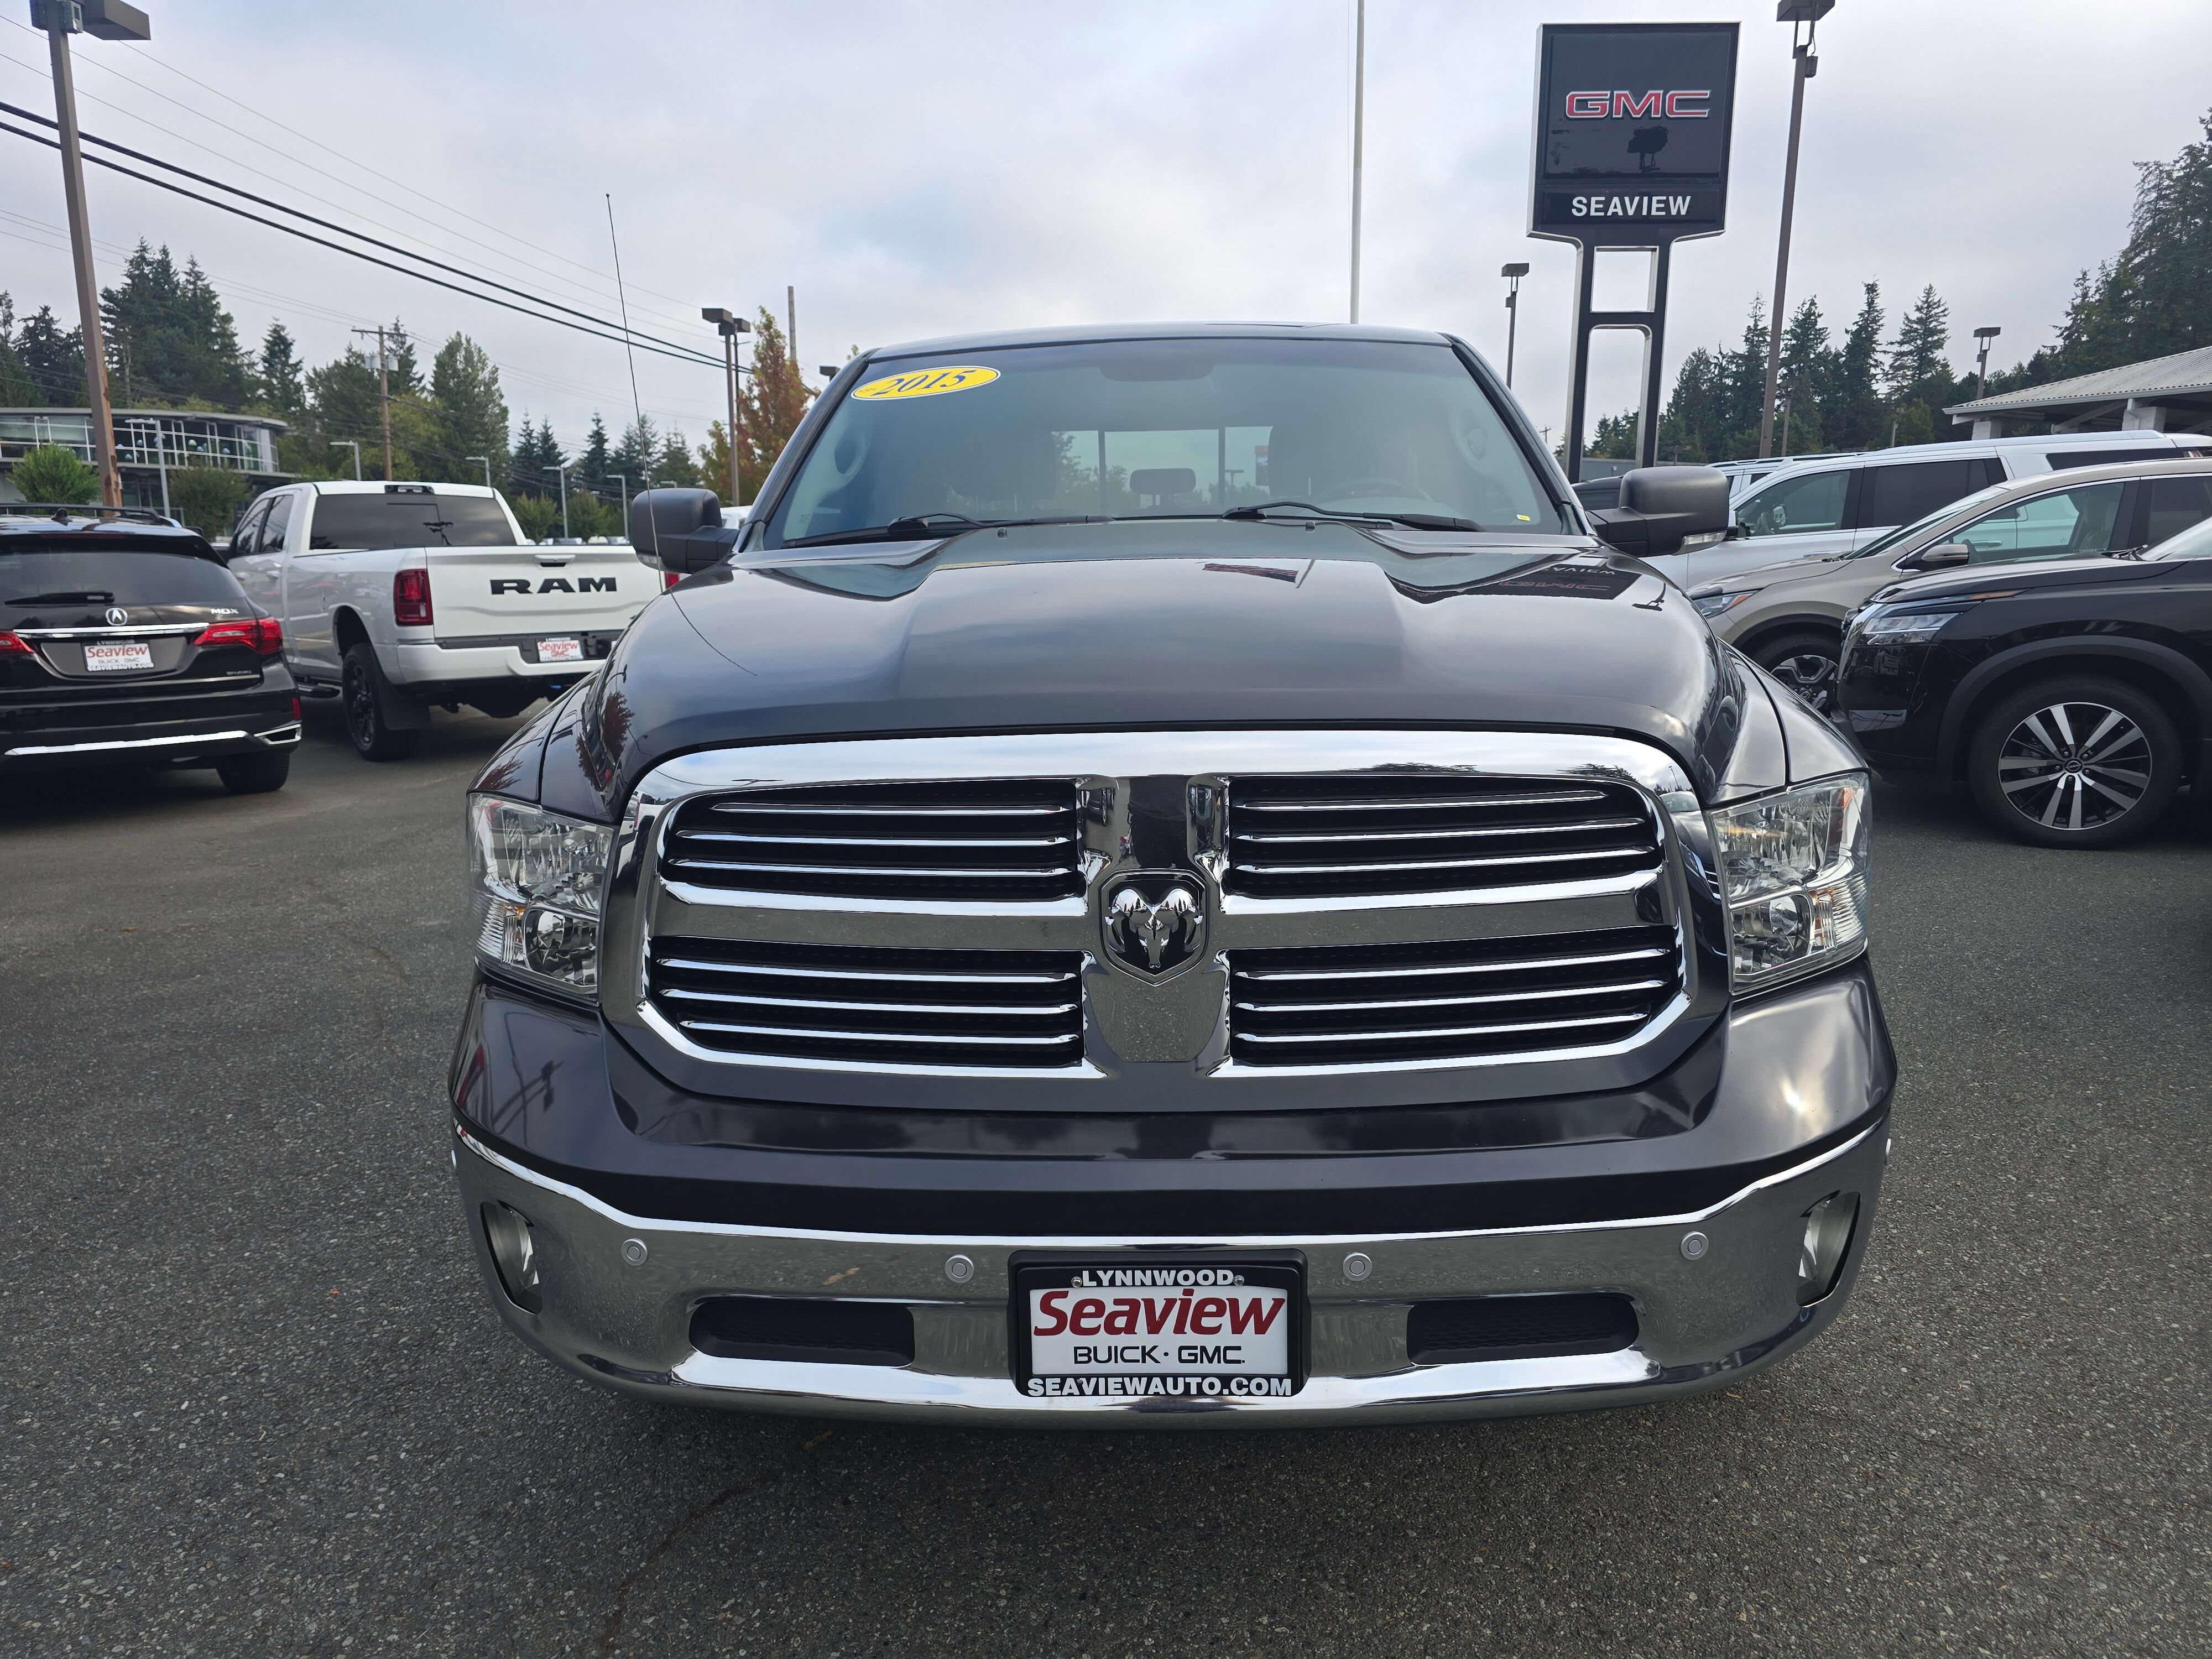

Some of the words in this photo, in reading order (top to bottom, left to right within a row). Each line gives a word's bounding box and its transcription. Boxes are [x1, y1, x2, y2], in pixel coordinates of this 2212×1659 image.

[1566, 90, 1710, 119] GMC
[1571, 196, 1691, 216] SEAVIEW
[870, 369, 977, 396] 2015
[490, 577, 617, 594] RAM
[87, 644, 148, 658] Seaview
[539, 641, 578, 651] Seaview
[1082, 1270, 1234, 1286] LYNNWOOD
[1033, 1288, 1285, 1336] Seaview
[1073, 1345, 1161, 1364] BUICK
[1028, 1377, 1291, 1396] SEAVIEWAUTO.COM
